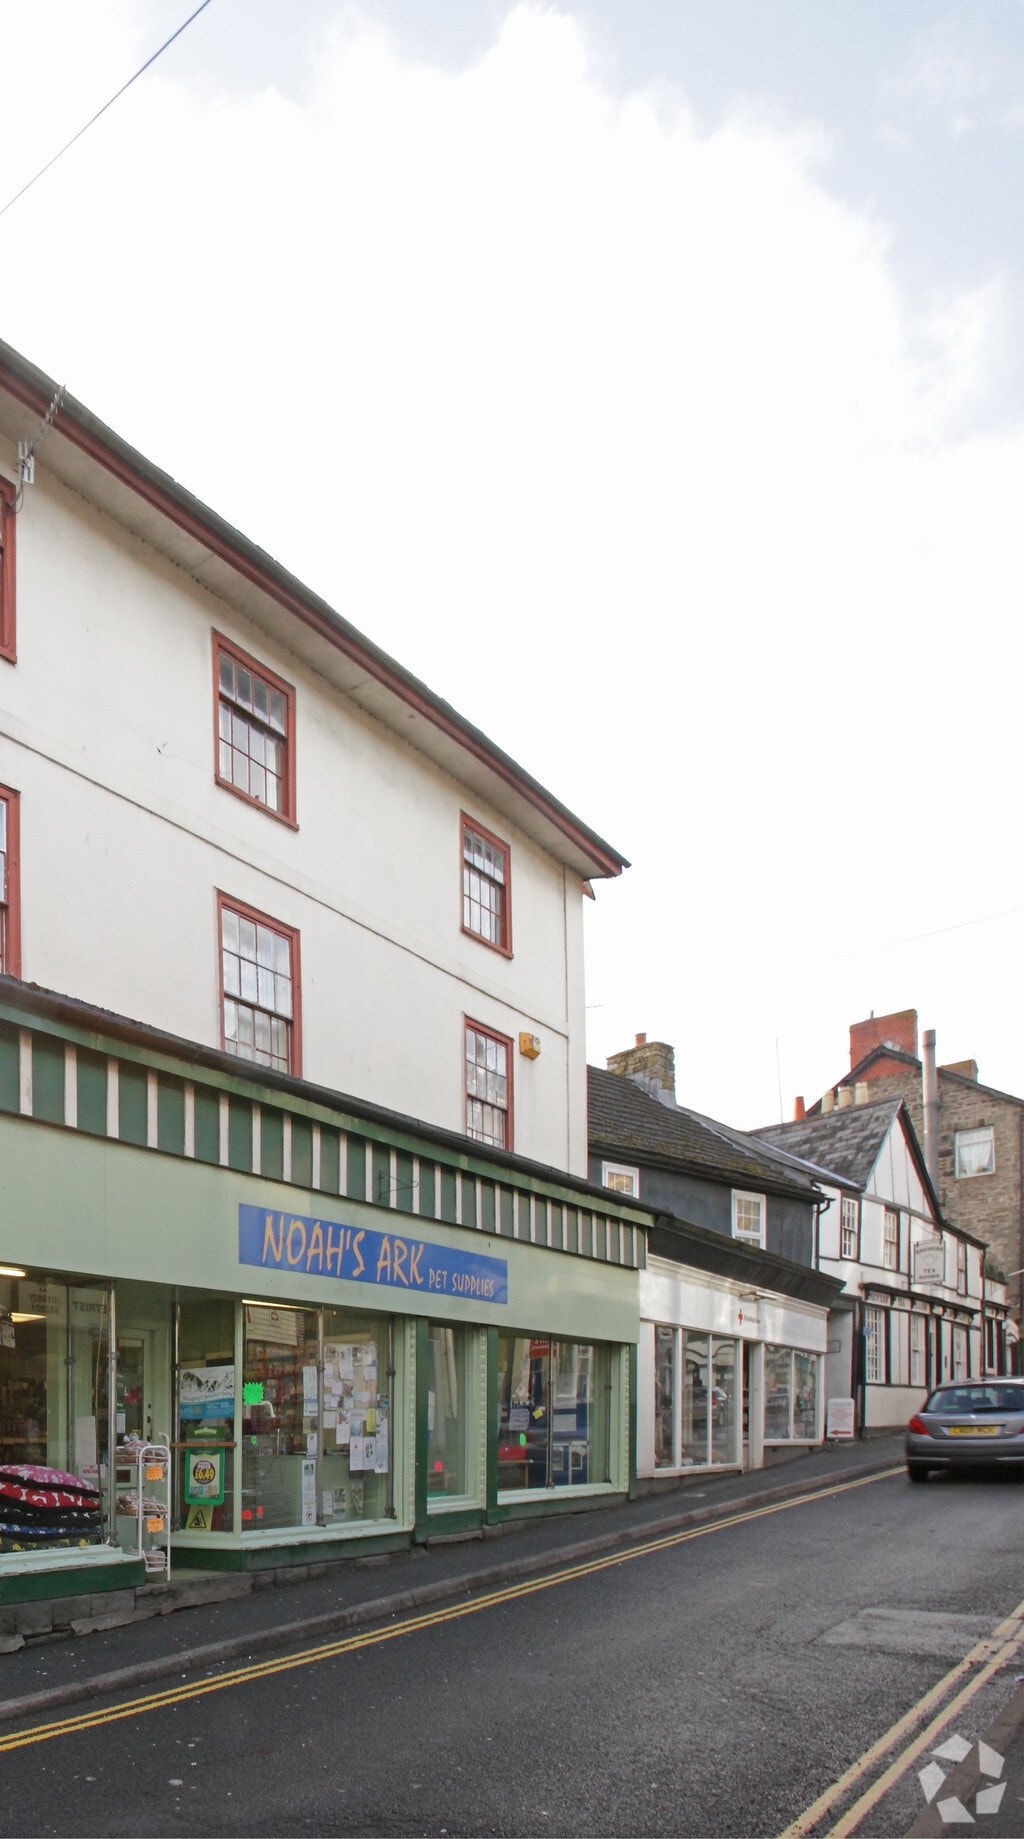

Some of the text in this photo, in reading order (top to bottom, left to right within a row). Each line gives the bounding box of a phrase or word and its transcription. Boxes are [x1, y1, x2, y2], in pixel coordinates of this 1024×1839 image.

[262, 1214, 495, 1298] NOAH'S ARK PET SUPPLIES
[194, 1468, 215, 1480] £6.49
